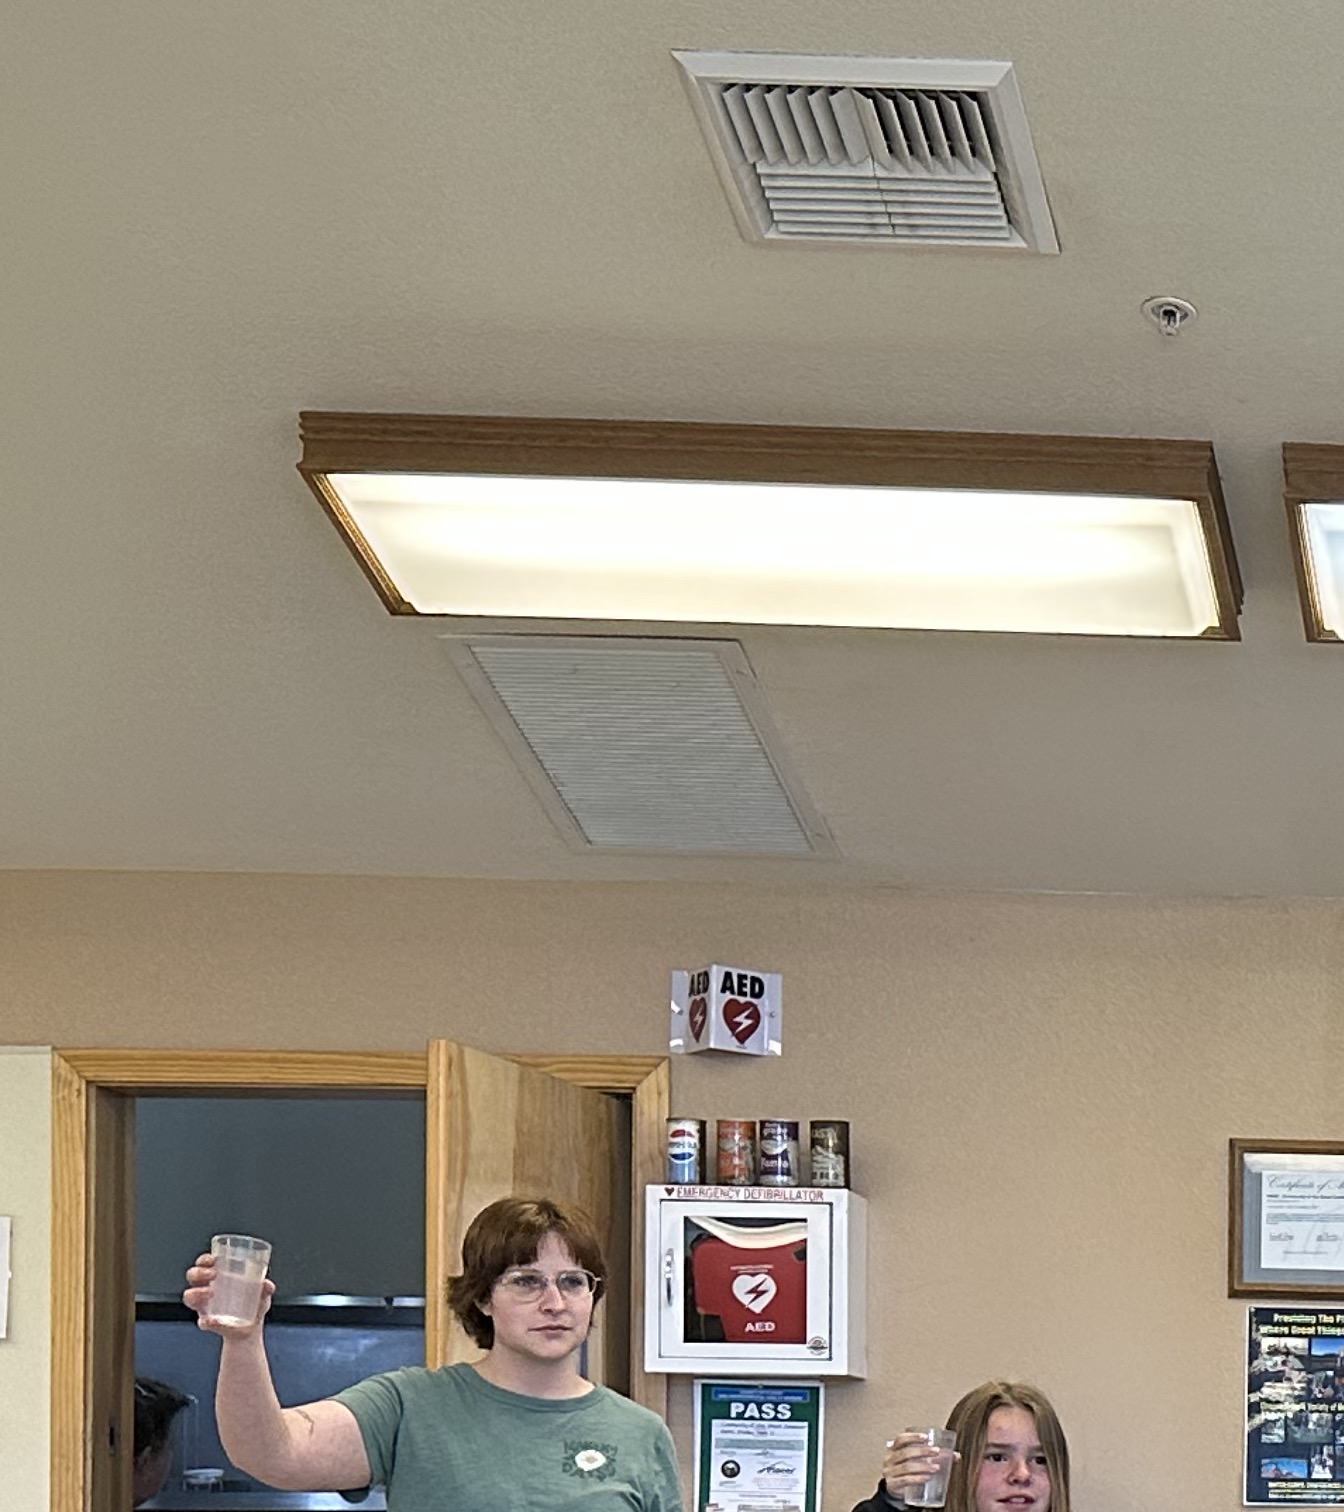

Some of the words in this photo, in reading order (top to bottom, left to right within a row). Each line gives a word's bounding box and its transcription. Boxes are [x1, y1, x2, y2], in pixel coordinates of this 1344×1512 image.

[688, 970, 710, 997] AED
[720, 971, 765, 999] AED
[676, 1187, 740, 1200] EMERGENCY
[743, 1188, 824, 1201] DEFIBRILLATOR
[744, 1322, 776, 1332] AED
[730, 1402, 792, 1420] PASS
